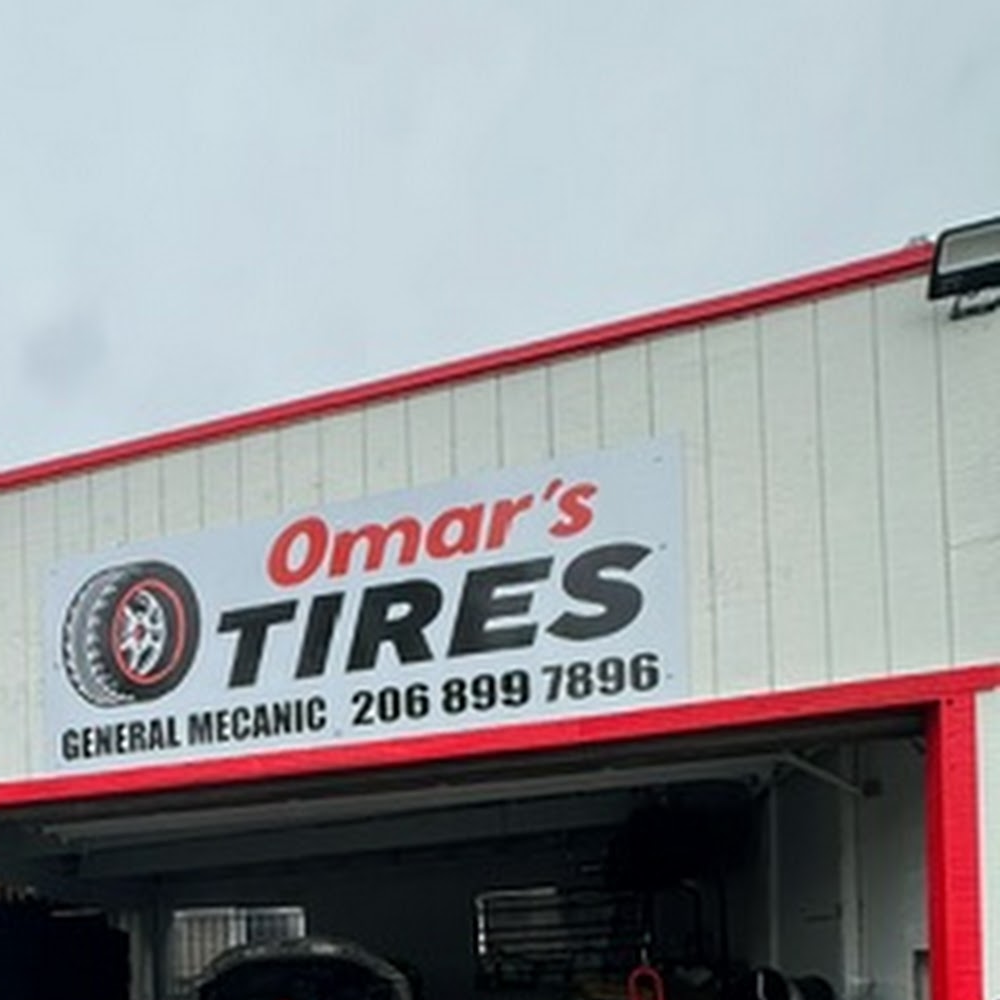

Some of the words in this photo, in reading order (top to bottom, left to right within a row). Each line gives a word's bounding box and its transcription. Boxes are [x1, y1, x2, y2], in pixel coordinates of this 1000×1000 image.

[267, 478, 598, 587] Omar's
[217, 542, 653, 688] TIRES
[61, 711, 181, 761] GENERAL
[187, 696, 327, 746] MECANIC
[351, 685, 430, 727] 206
[441, 668, 531, 714] 899
[542, 652, 661, 702] 7896
